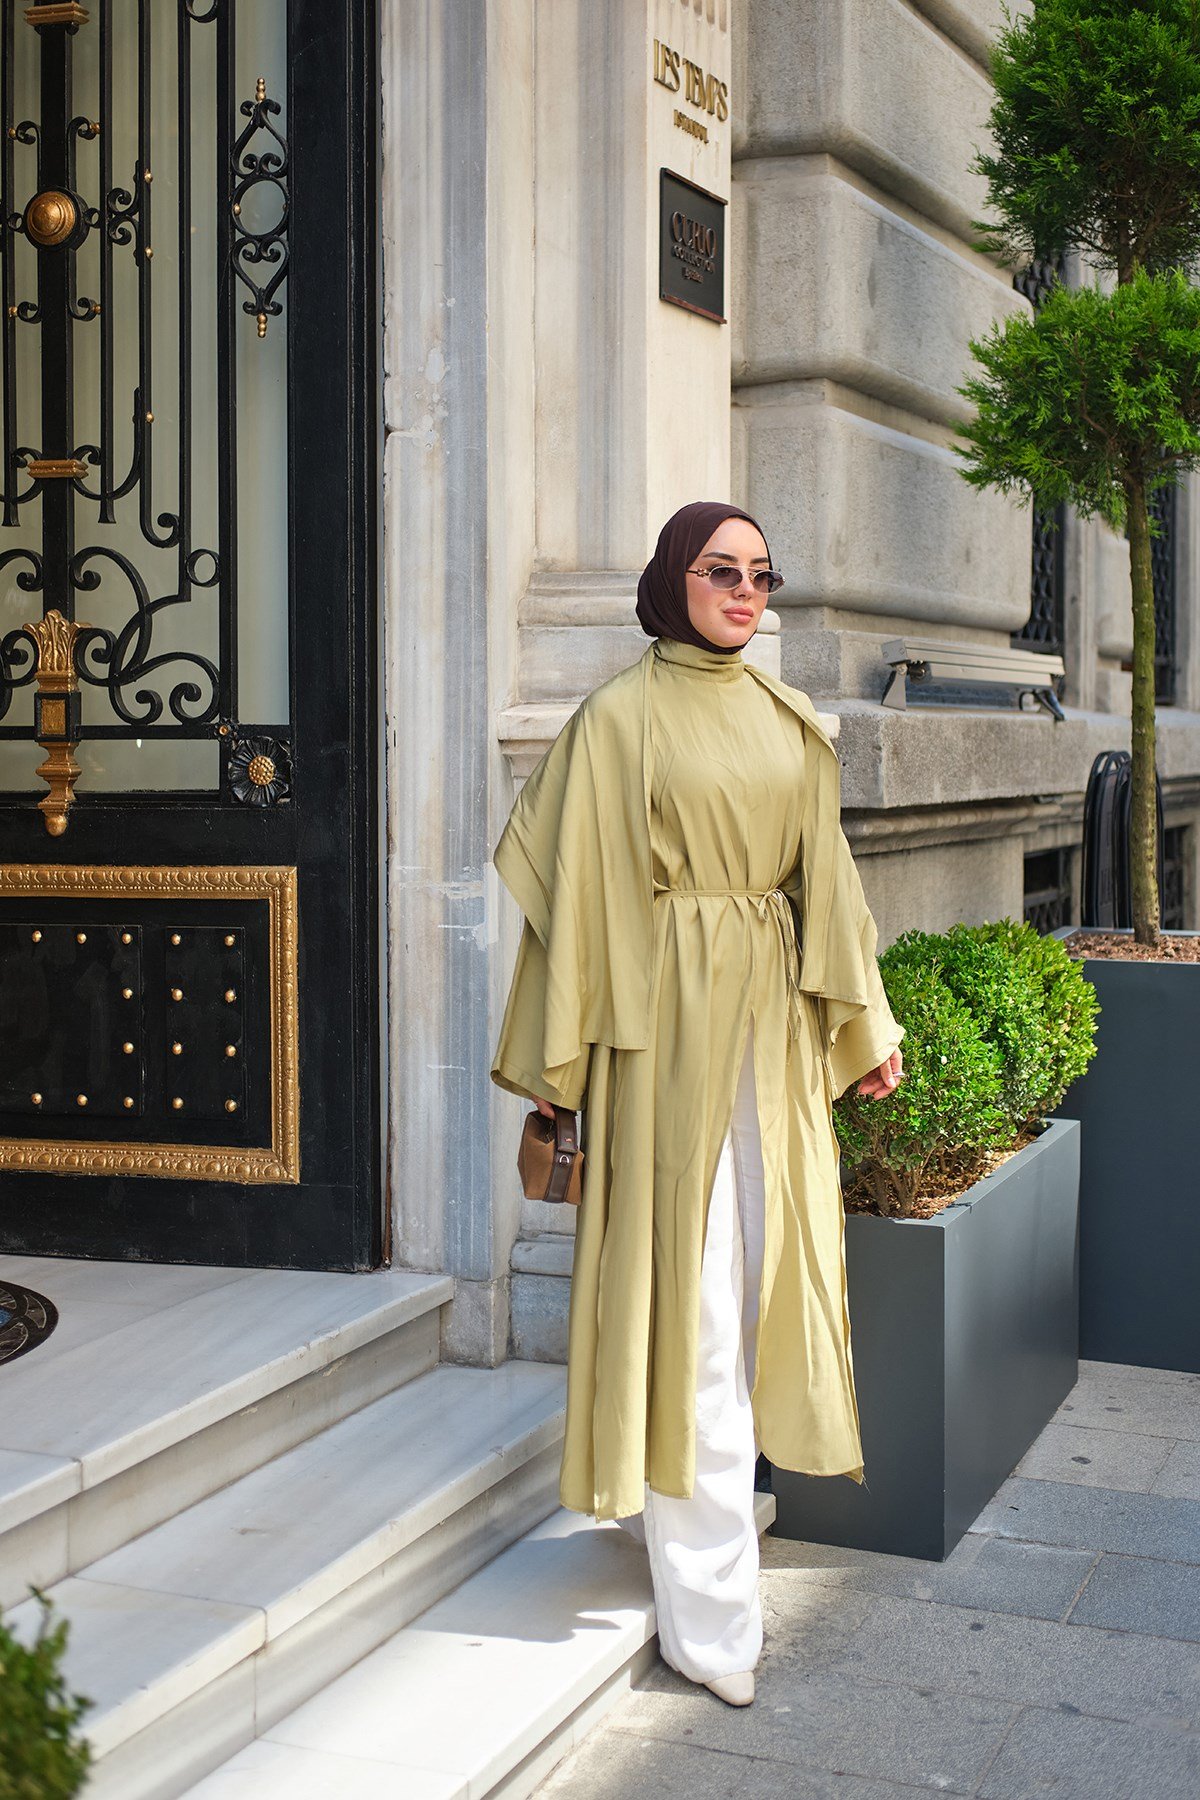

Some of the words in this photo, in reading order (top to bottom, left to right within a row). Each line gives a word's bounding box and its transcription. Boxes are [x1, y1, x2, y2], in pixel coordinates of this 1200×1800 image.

[653, 38, 680, 92] LES
[682, 58, 728, 122] TEMPS
[671, 211, 717, 259] CURIO
